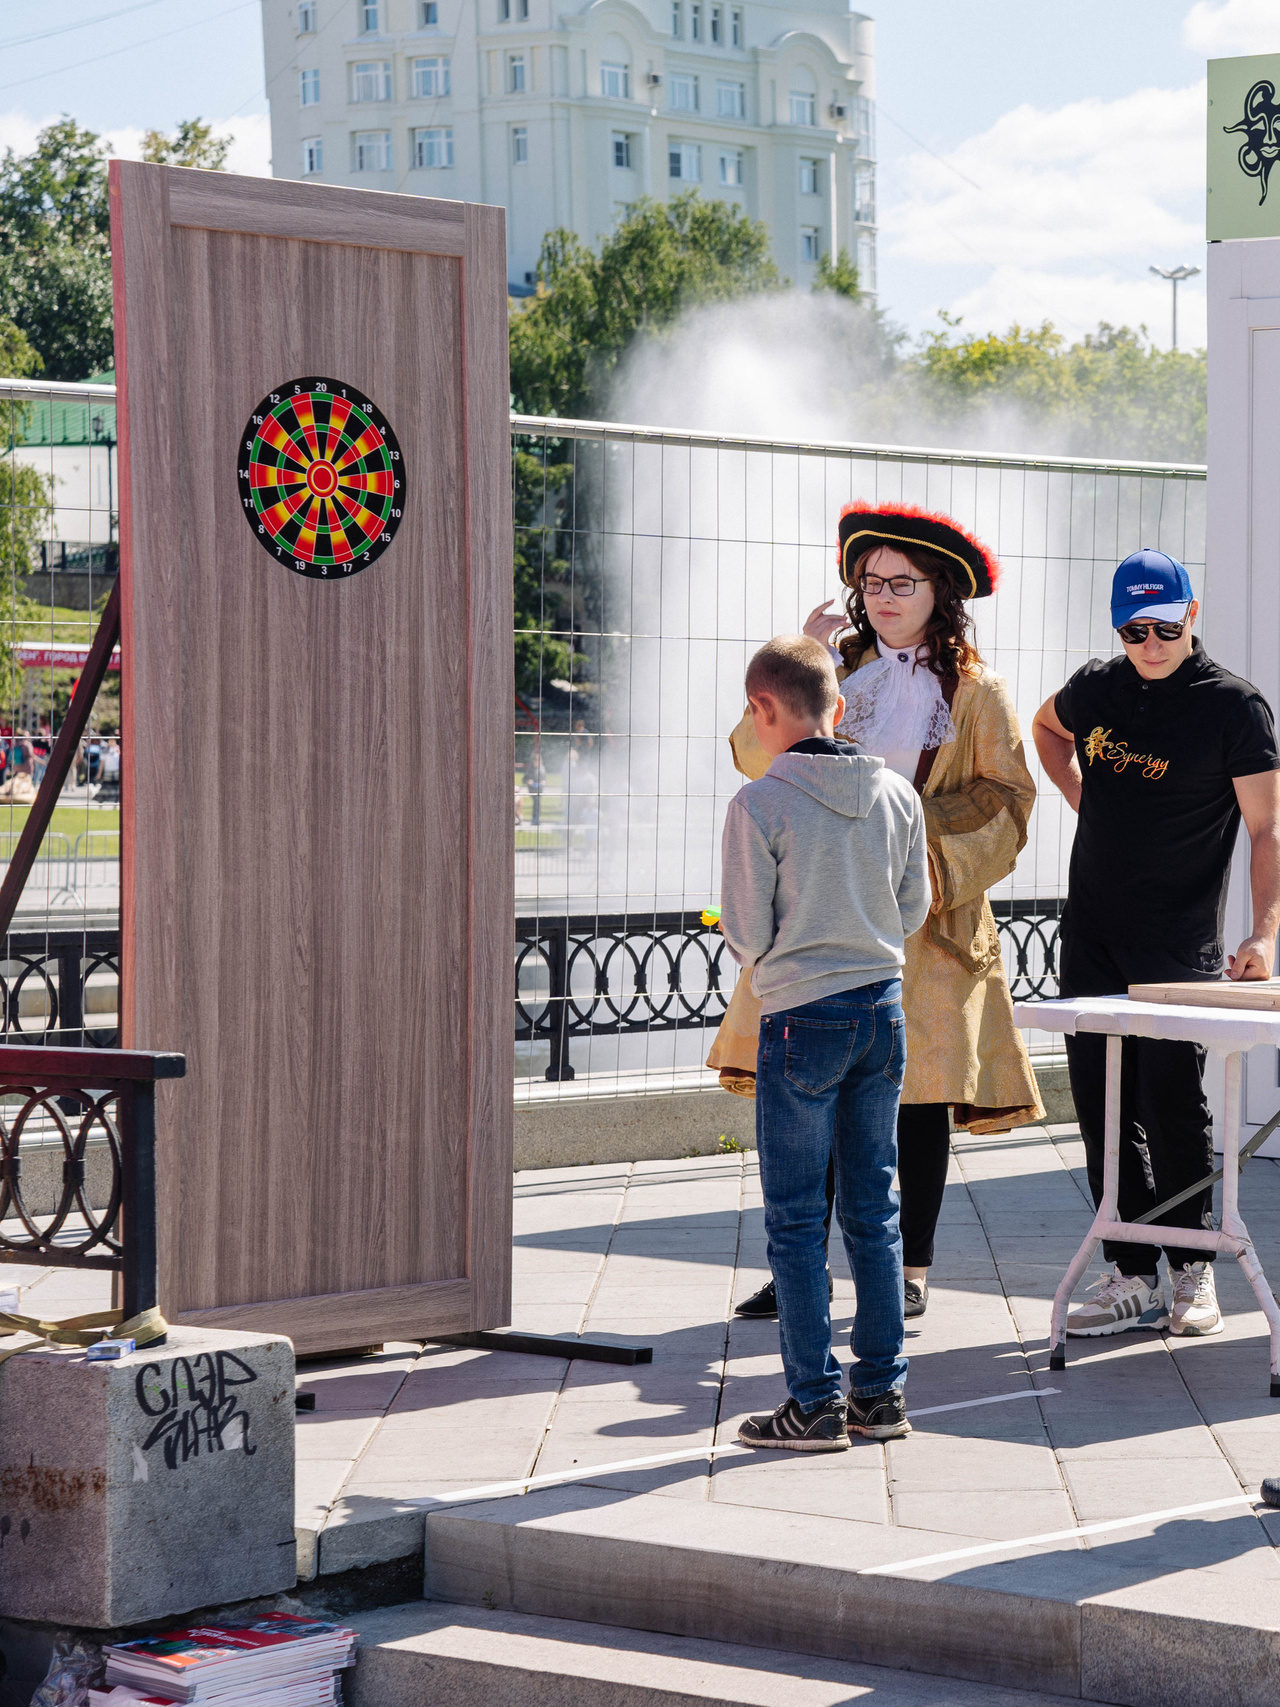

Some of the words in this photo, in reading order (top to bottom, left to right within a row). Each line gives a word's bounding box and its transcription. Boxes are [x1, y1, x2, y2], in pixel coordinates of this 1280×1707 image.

[294, 385, 301, 394] 5
[315, 382, 327, 392] 20
[341, 389, 347, 398] 1
[269, 394, 280, 403] 12
[362, 404, 373, 413] 18
[252, 416, 263, 425] 16
[379, 426, 386, 435] 4
[246, 441, 253, 450] 9
[389, 451, 400, 460] 13
[238, 470, 250, 479] 14
[394, 479, 400, 489] 6
[243, 499, 254, 508] 11
[391, 509, 402, 518] 10
[258, 525, 265, 534] 8
[381, 532, 391, 542] 15
[276, 547, 283, 556] 7
[363, 552, 370, 560] 2
[295, 561, 306, 570] 19
[321, 565, 328, 575] 3
[342, 563, 353, 572] 17
[1106, 741, 1170, 780] Synergy
